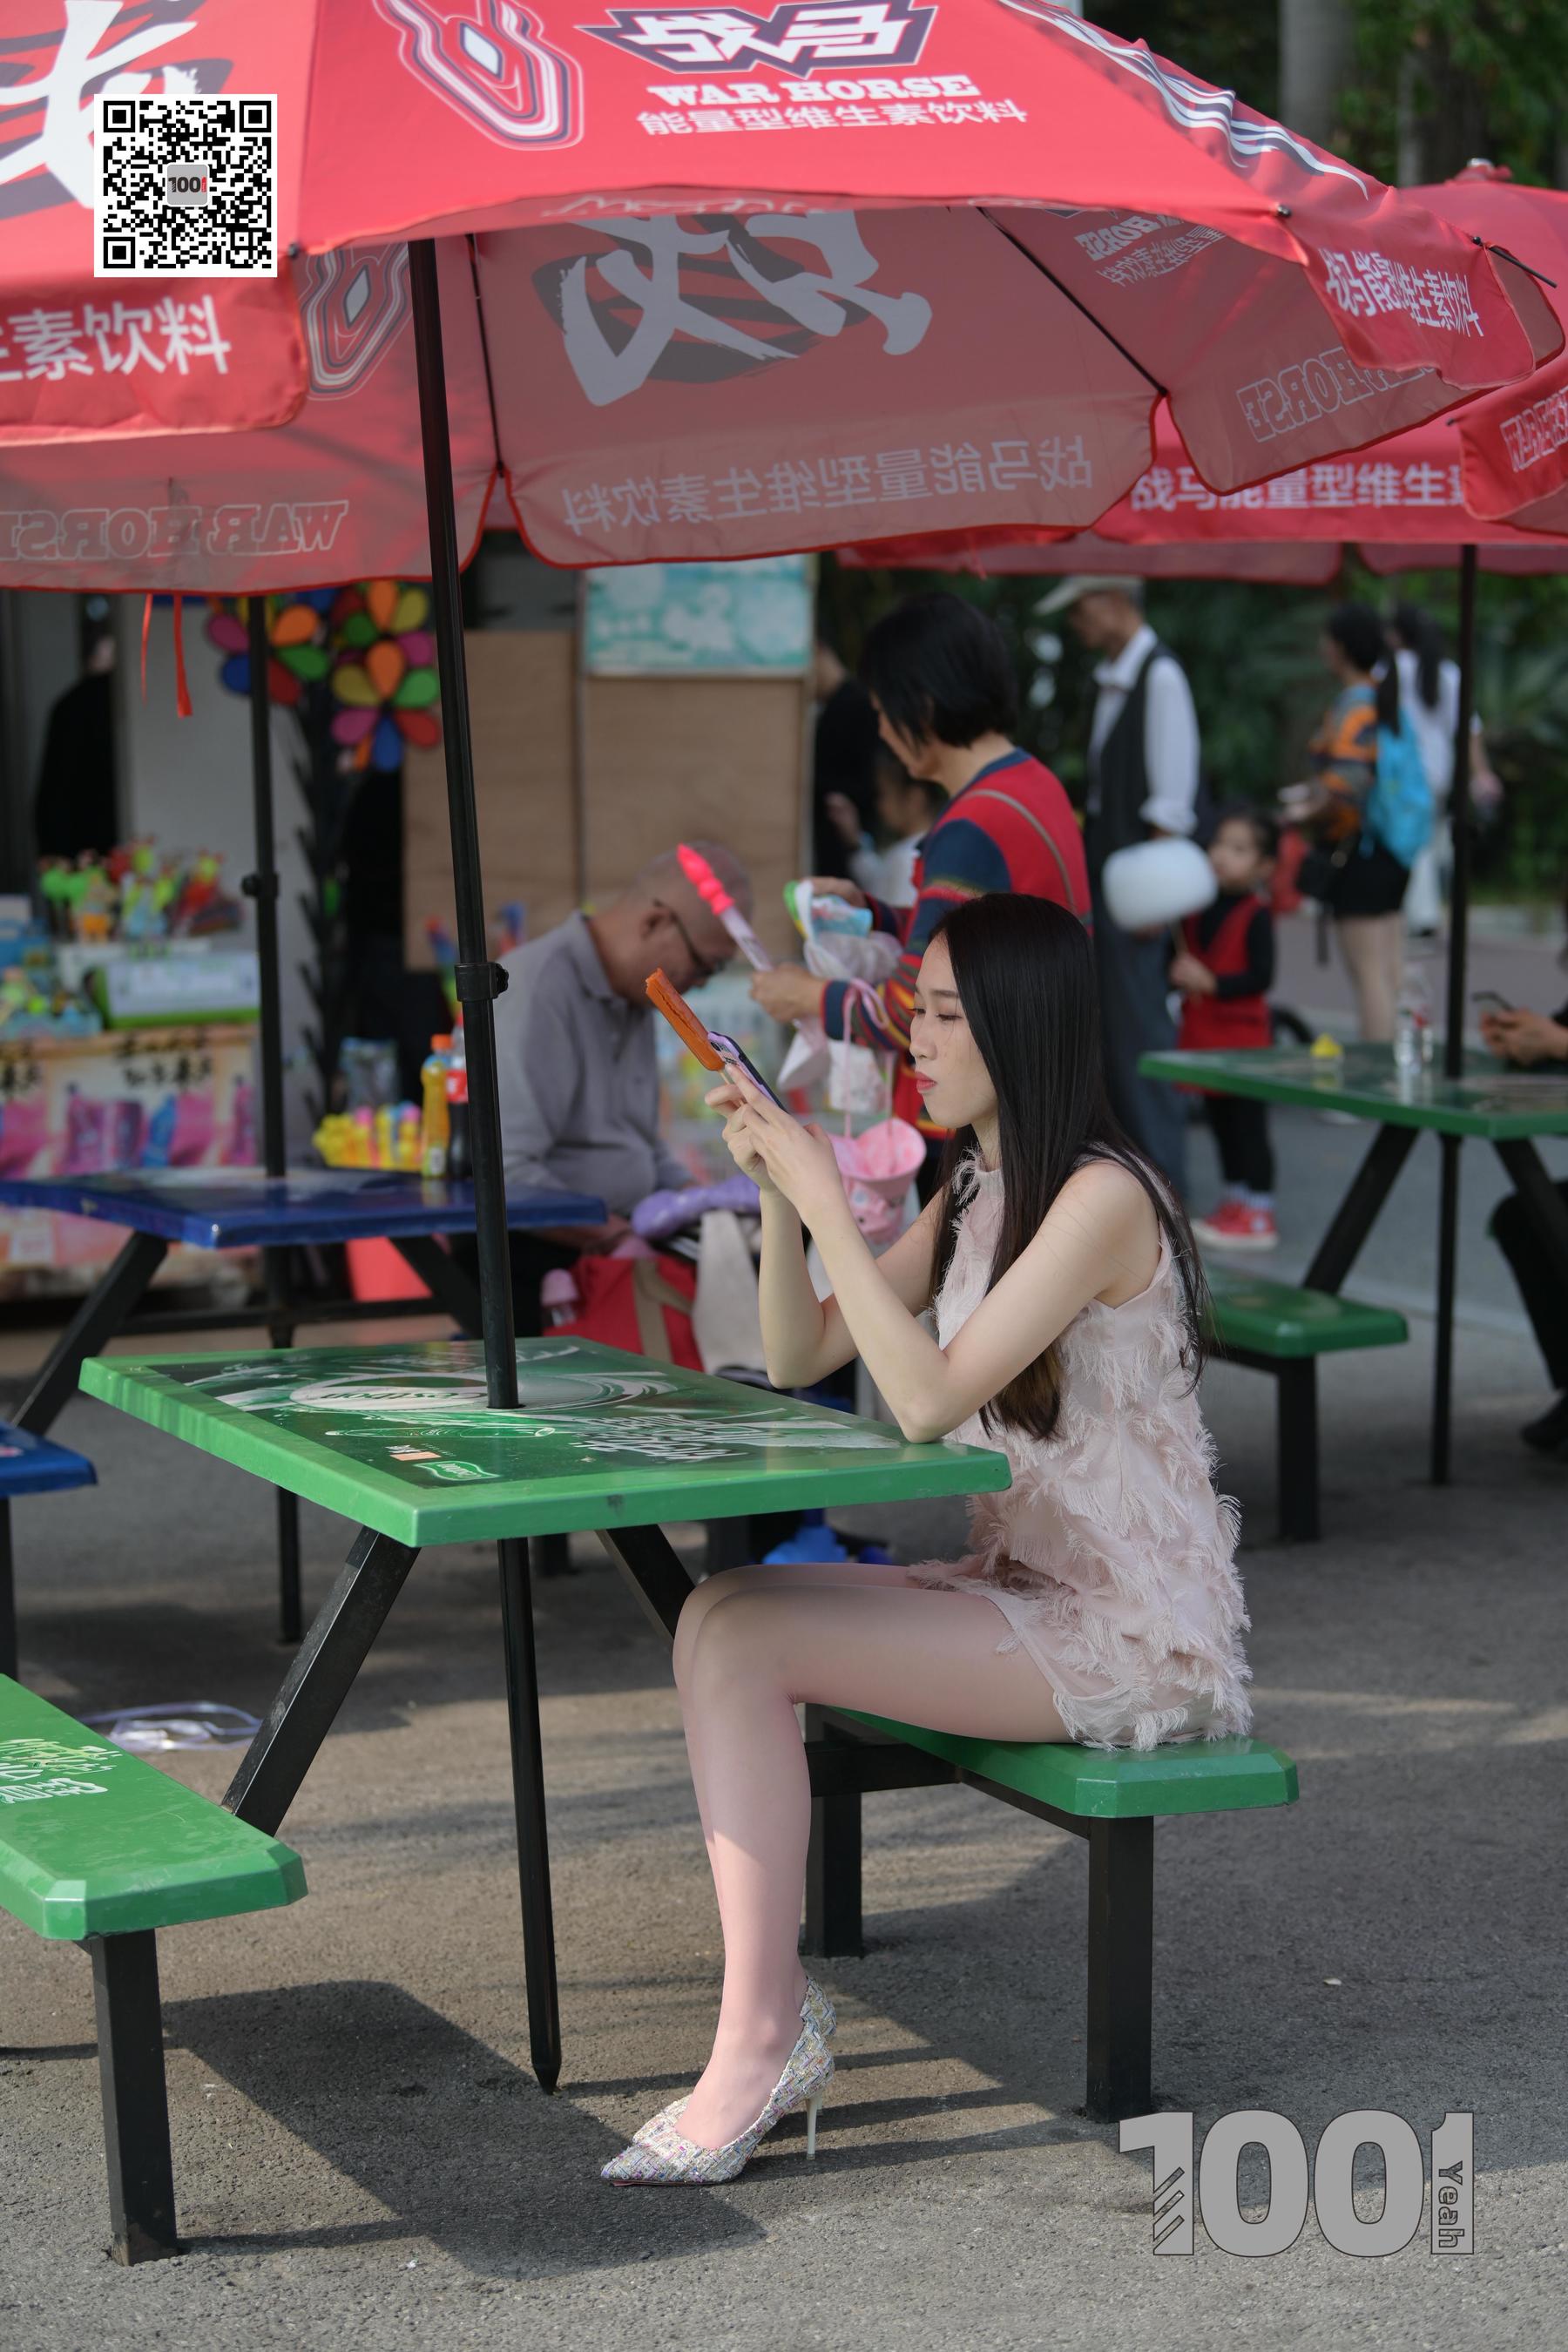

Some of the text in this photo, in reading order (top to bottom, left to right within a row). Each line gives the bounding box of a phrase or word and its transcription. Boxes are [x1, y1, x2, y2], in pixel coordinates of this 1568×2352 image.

[646, 75, 982, 106] WAR HORSE
[636, 98, 1028, 136] 能量型维生素饮料
